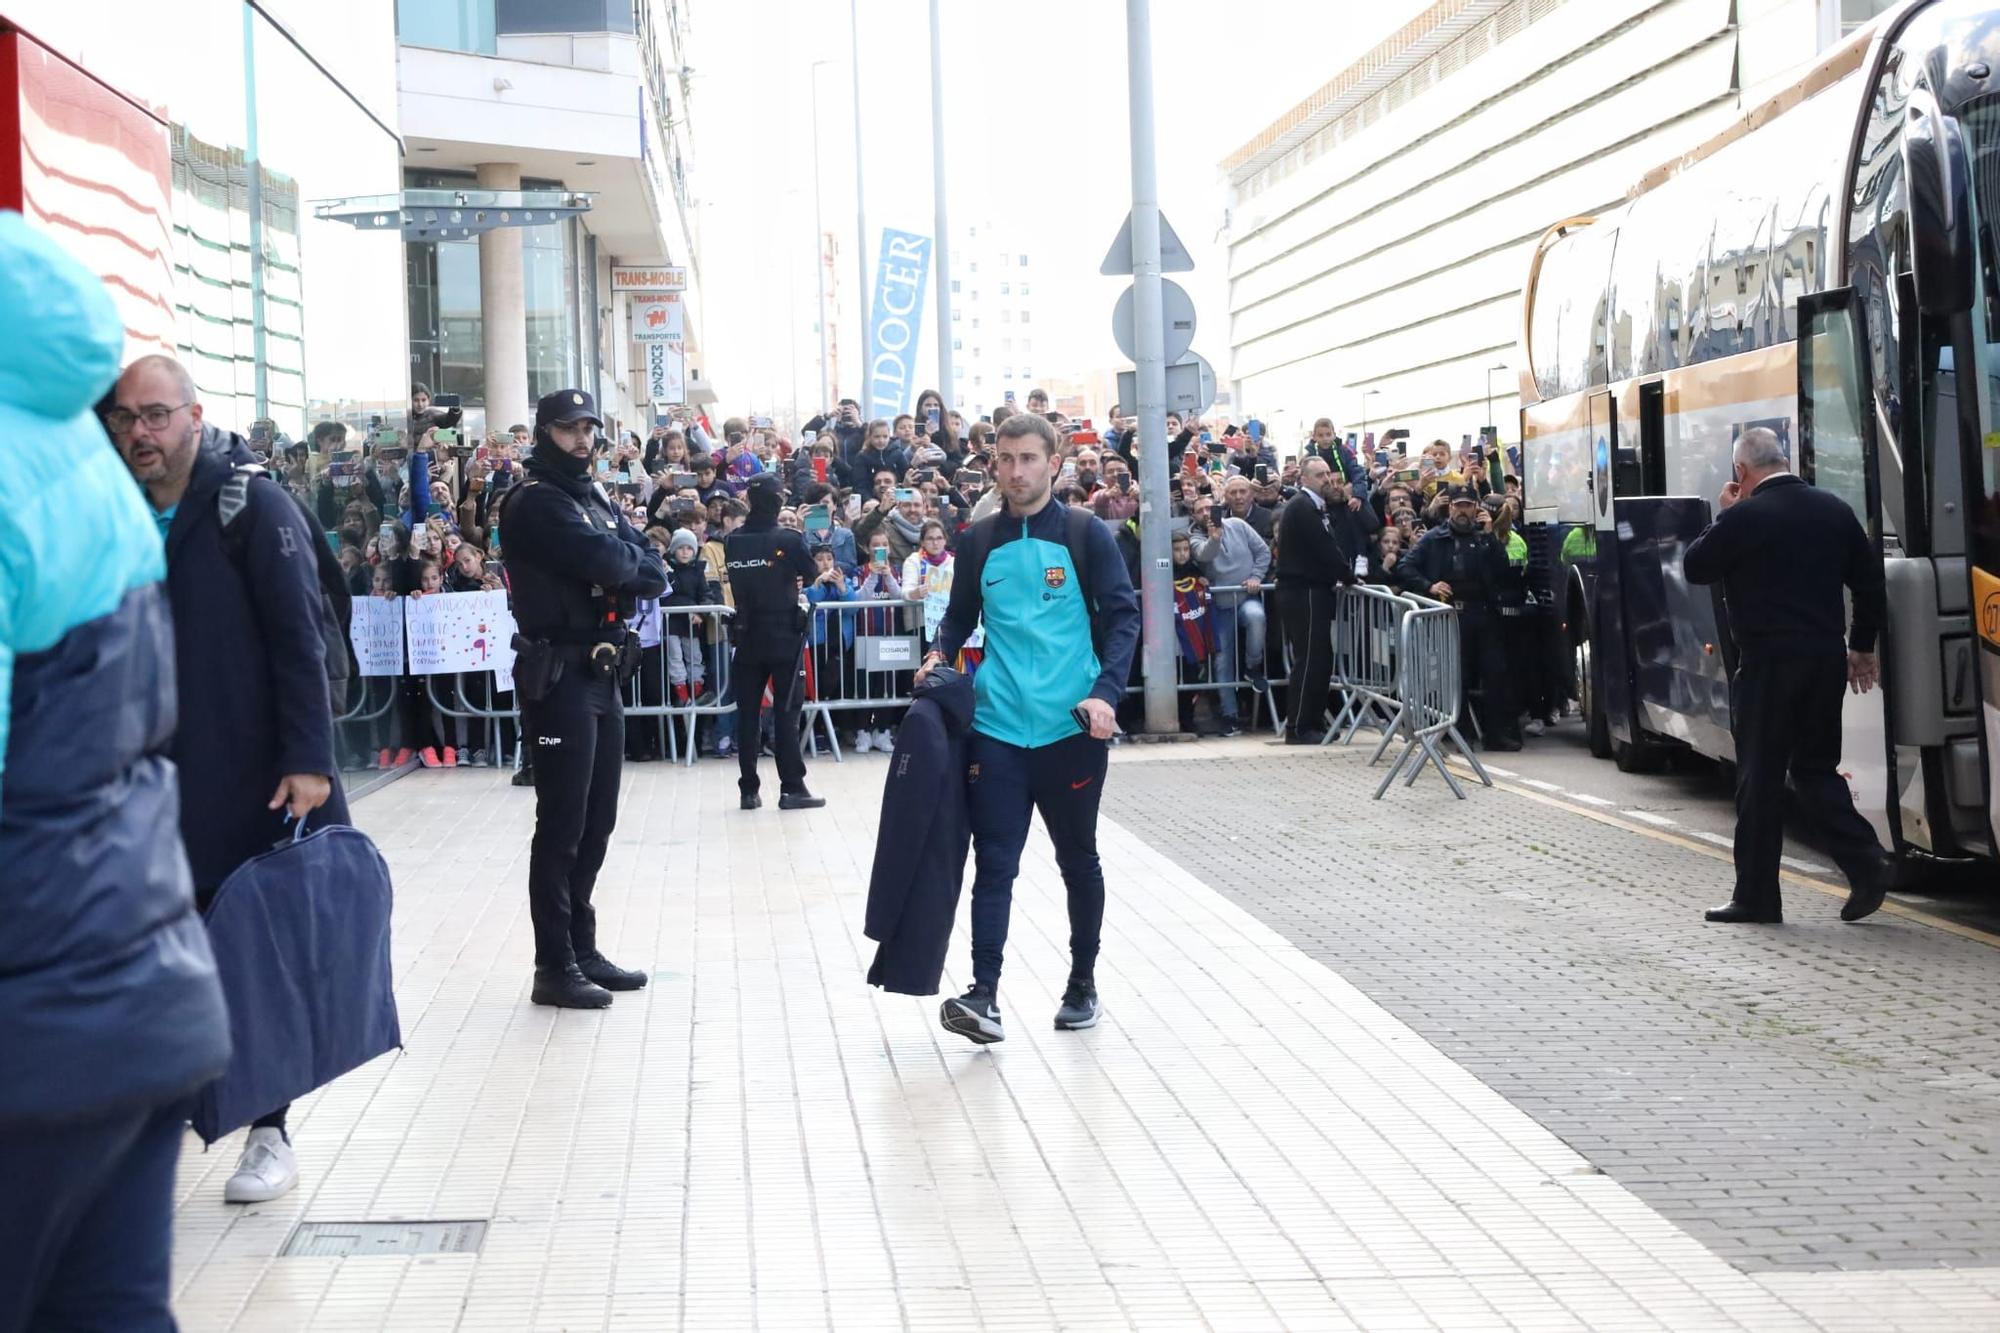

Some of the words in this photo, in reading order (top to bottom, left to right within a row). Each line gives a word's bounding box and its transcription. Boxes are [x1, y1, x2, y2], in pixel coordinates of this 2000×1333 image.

[614, 271, 684, 286] TRANS-MOBLE
[633, 294, 681, 303] TRANS-MOBLE
[651, 344, 665, 398] MUDANZAS
[727, 559, 768, 569] POLICIA
[538, 736, 562, 746] CNP
